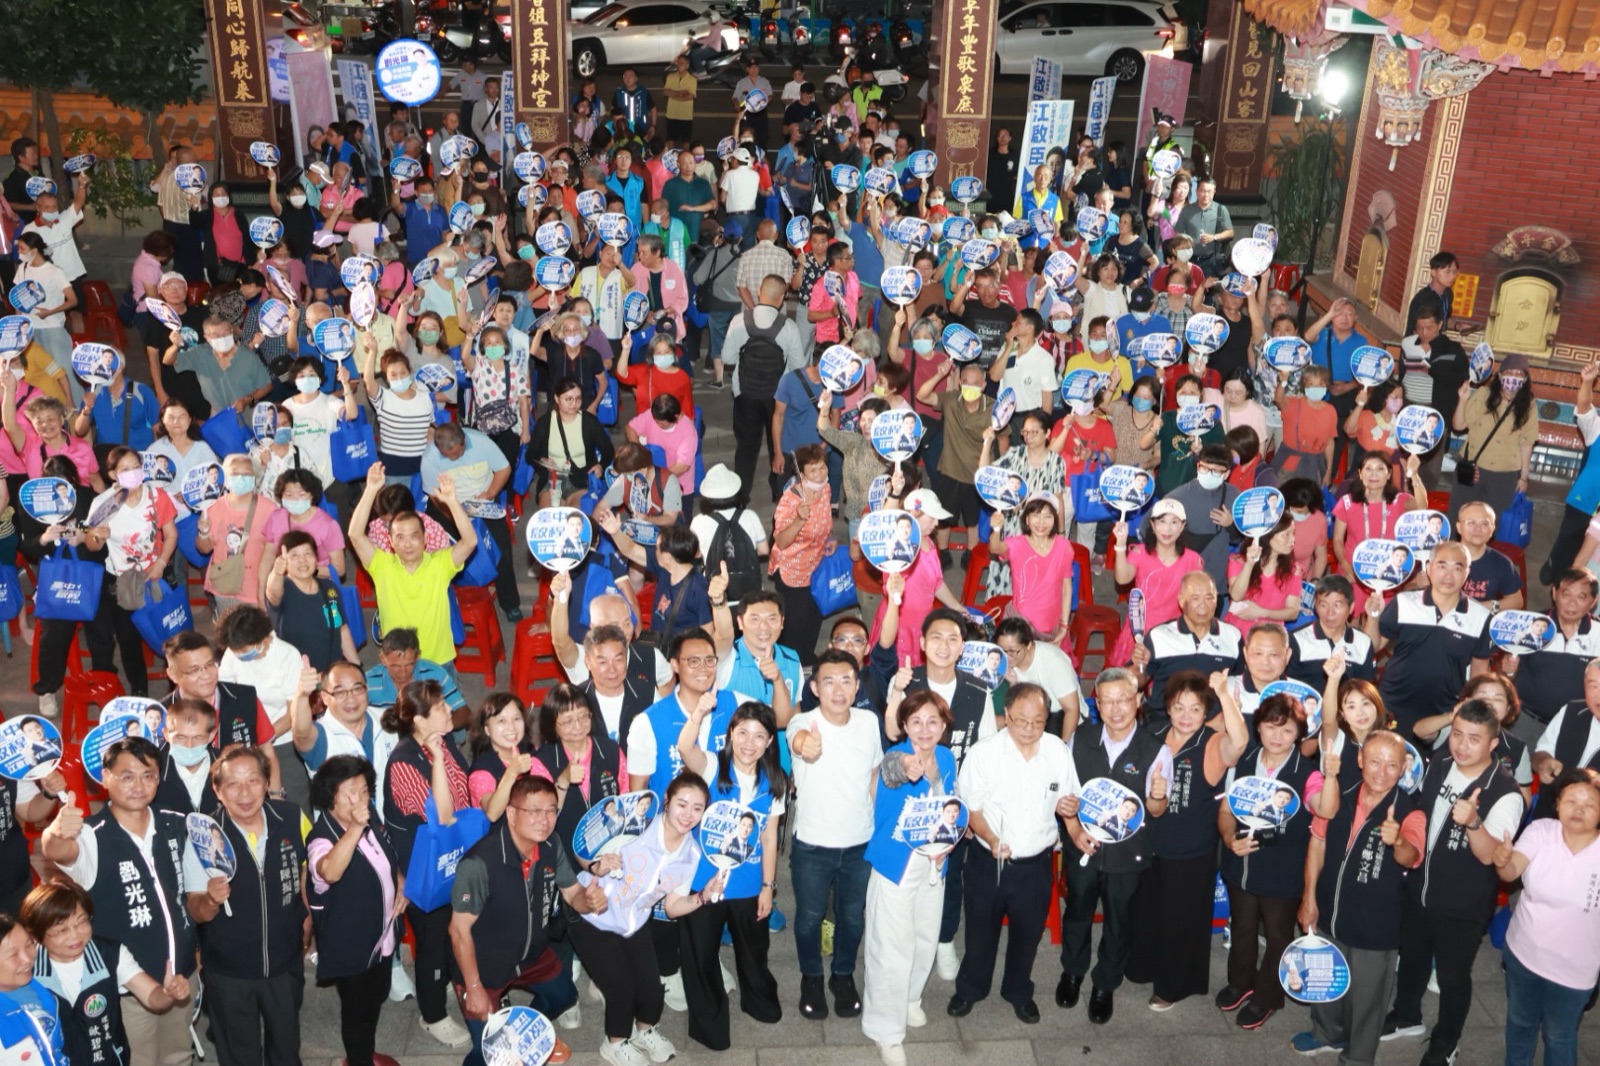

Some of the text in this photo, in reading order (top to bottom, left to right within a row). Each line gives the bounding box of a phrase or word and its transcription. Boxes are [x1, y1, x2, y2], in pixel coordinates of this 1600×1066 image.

[1028, 103, 1049, 166] 江啟臣
[530, 527, 565, 538] 啟程
[862, 530, 894, 542] 啟程
[1356, 552, 1389, 562] 啟程
[1082, 788, 1118, 810] 啟程
[1232, 786, 1271, 801] 啟程
[715, 803, 744, 819] 臺中
[912, 800, 945, 812] 臺中
[704, 816, 737, 833] 啟程
[904, 814, 941, 828] 啟程
[118, 860, 152, 928] 劉光琳
